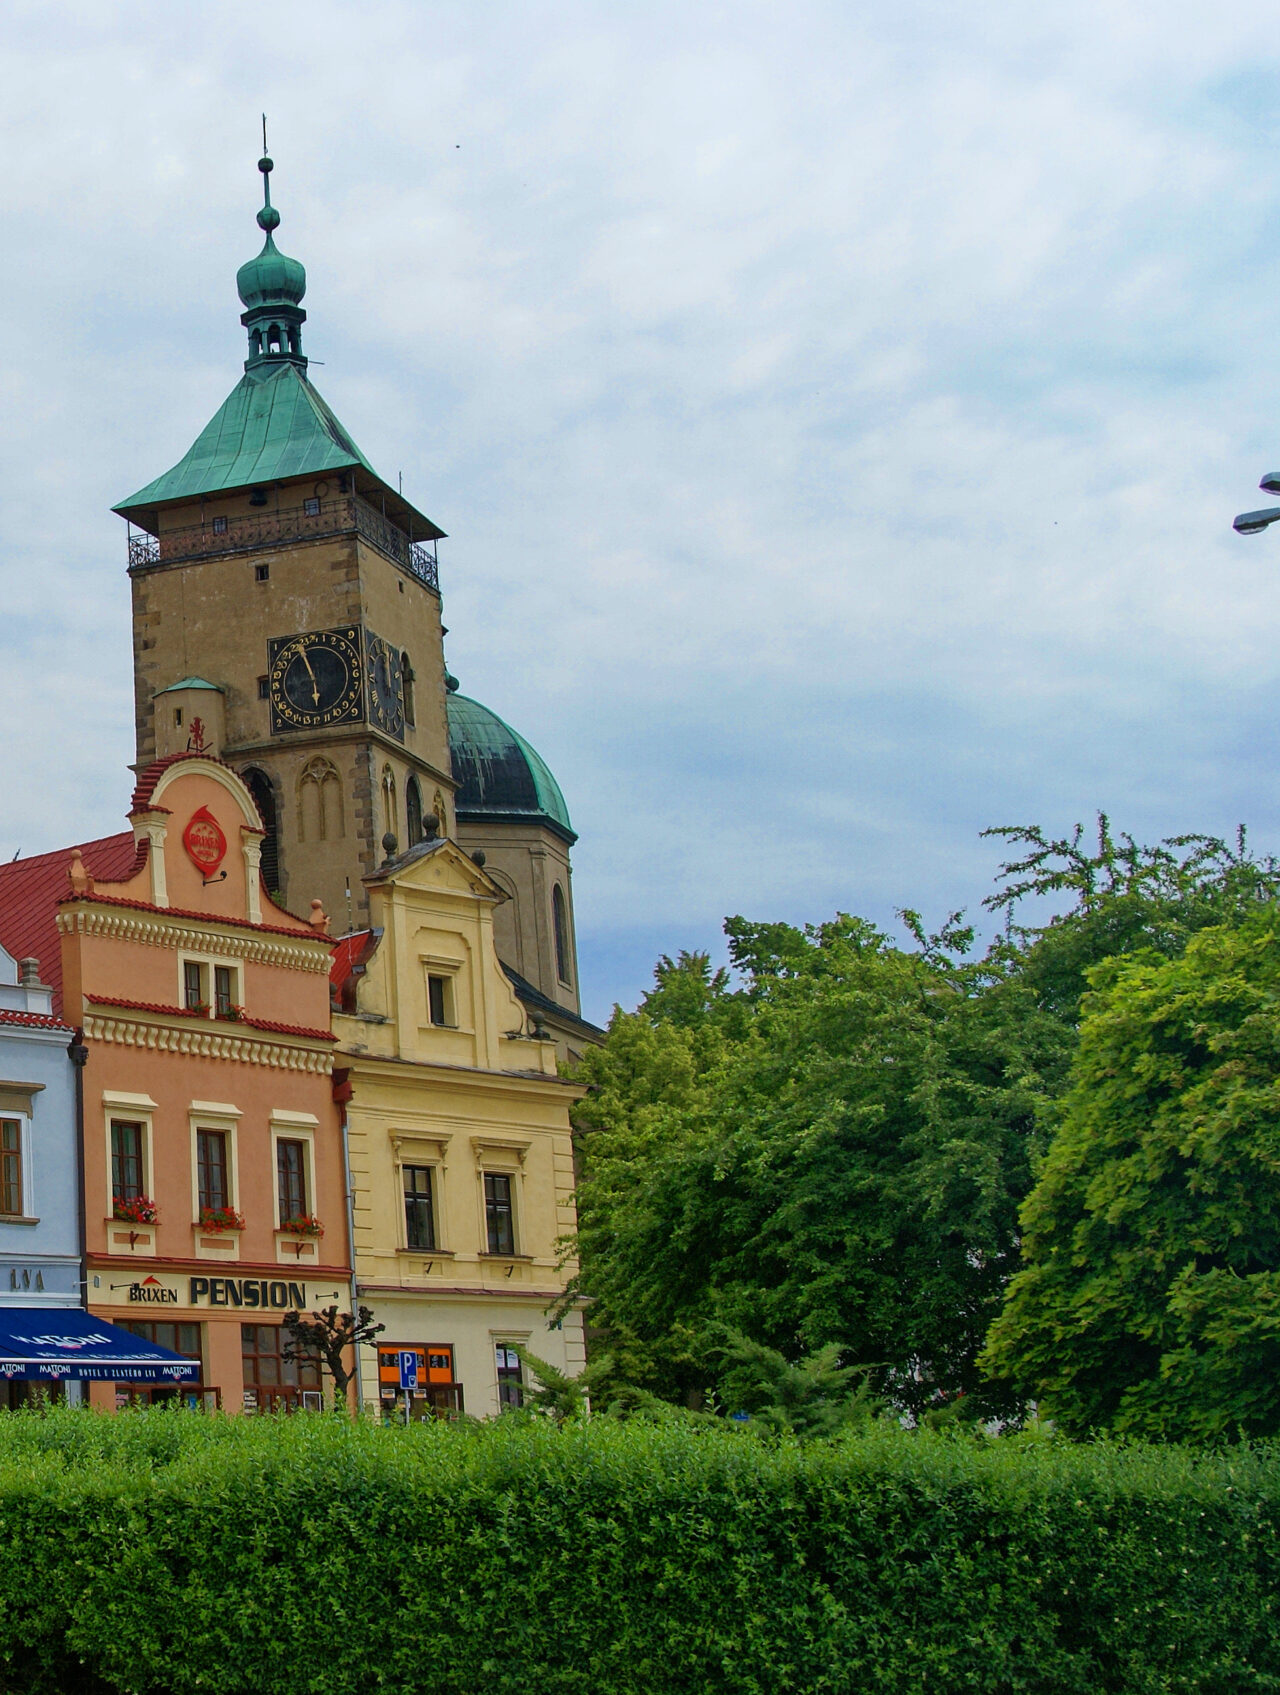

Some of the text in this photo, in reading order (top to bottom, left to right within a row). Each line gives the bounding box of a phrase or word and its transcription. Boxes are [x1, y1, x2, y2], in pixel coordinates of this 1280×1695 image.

[10, 1268, 44, 1290] LVA
[129, 1277, 306, 1309] BRIXEN PENSION
[9, 1333, 113, 1347] MATTONI
[39, 1364, 71, 1374] MATTONI
[162, 1366, 193, 1376] MATTONI
[404, 1353, 413, 1374] P
